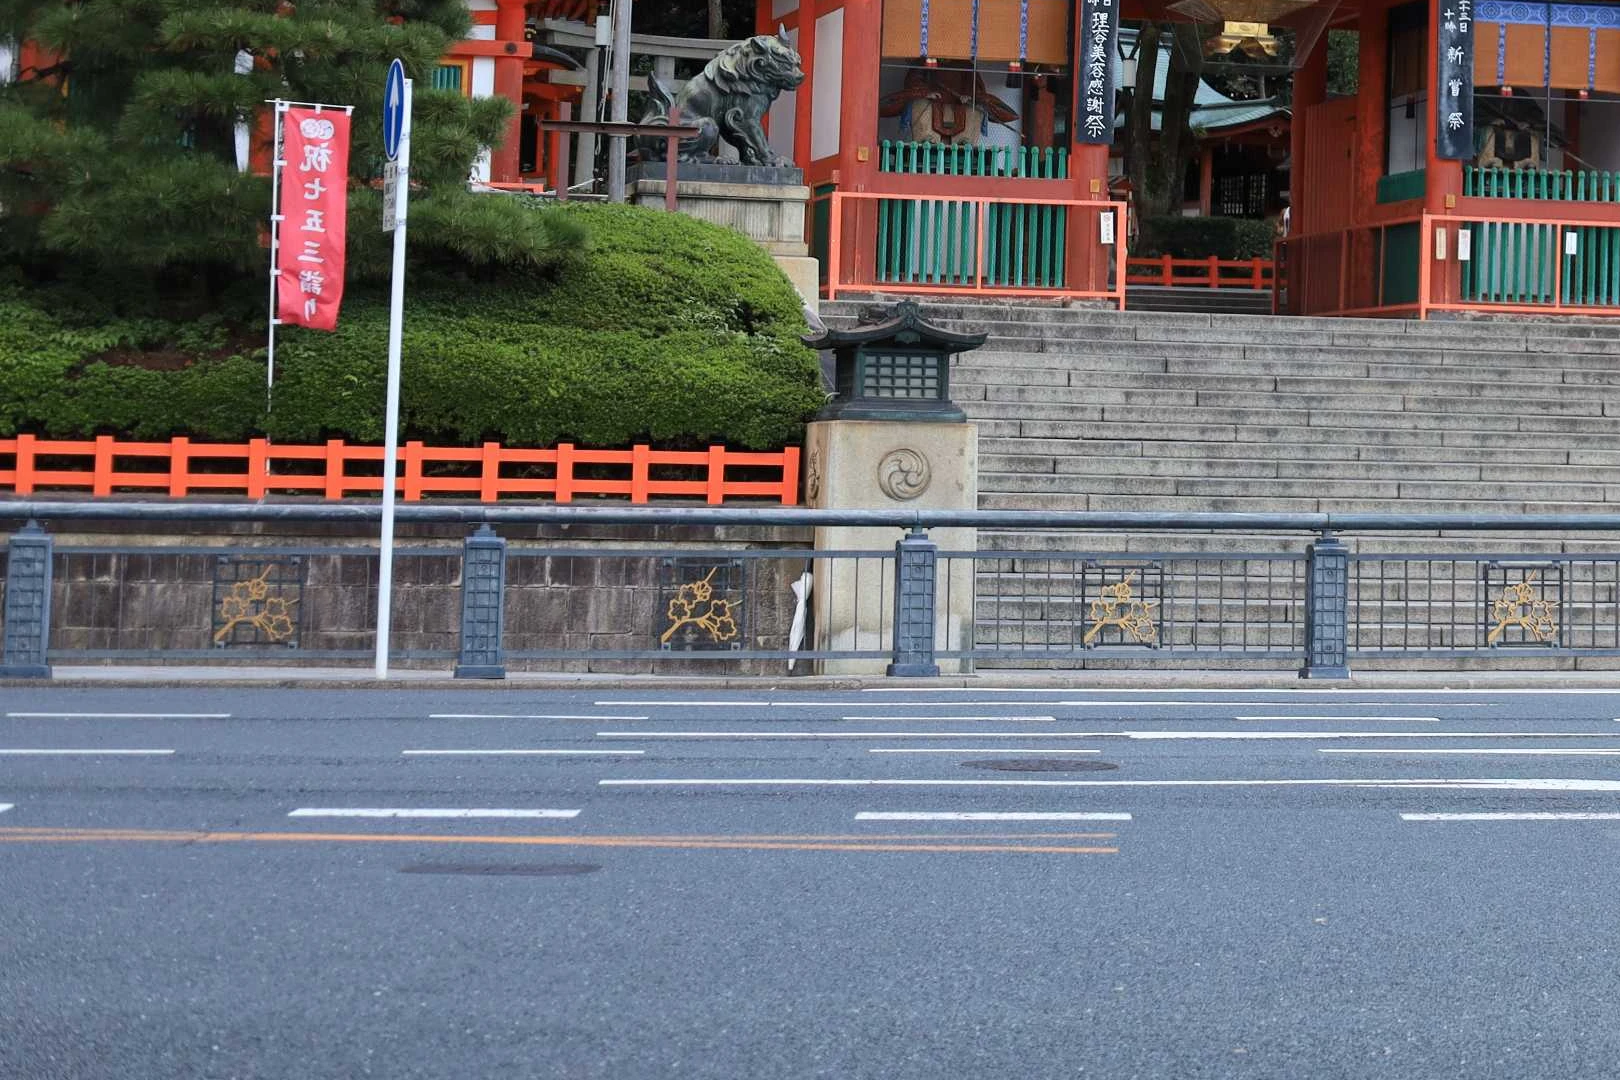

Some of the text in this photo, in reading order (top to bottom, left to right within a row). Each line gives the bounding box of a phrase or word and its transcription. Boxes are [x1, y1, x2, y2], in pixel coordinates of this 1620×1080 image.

[1083, 11, 1110, 138] 理容美容感謝祭
